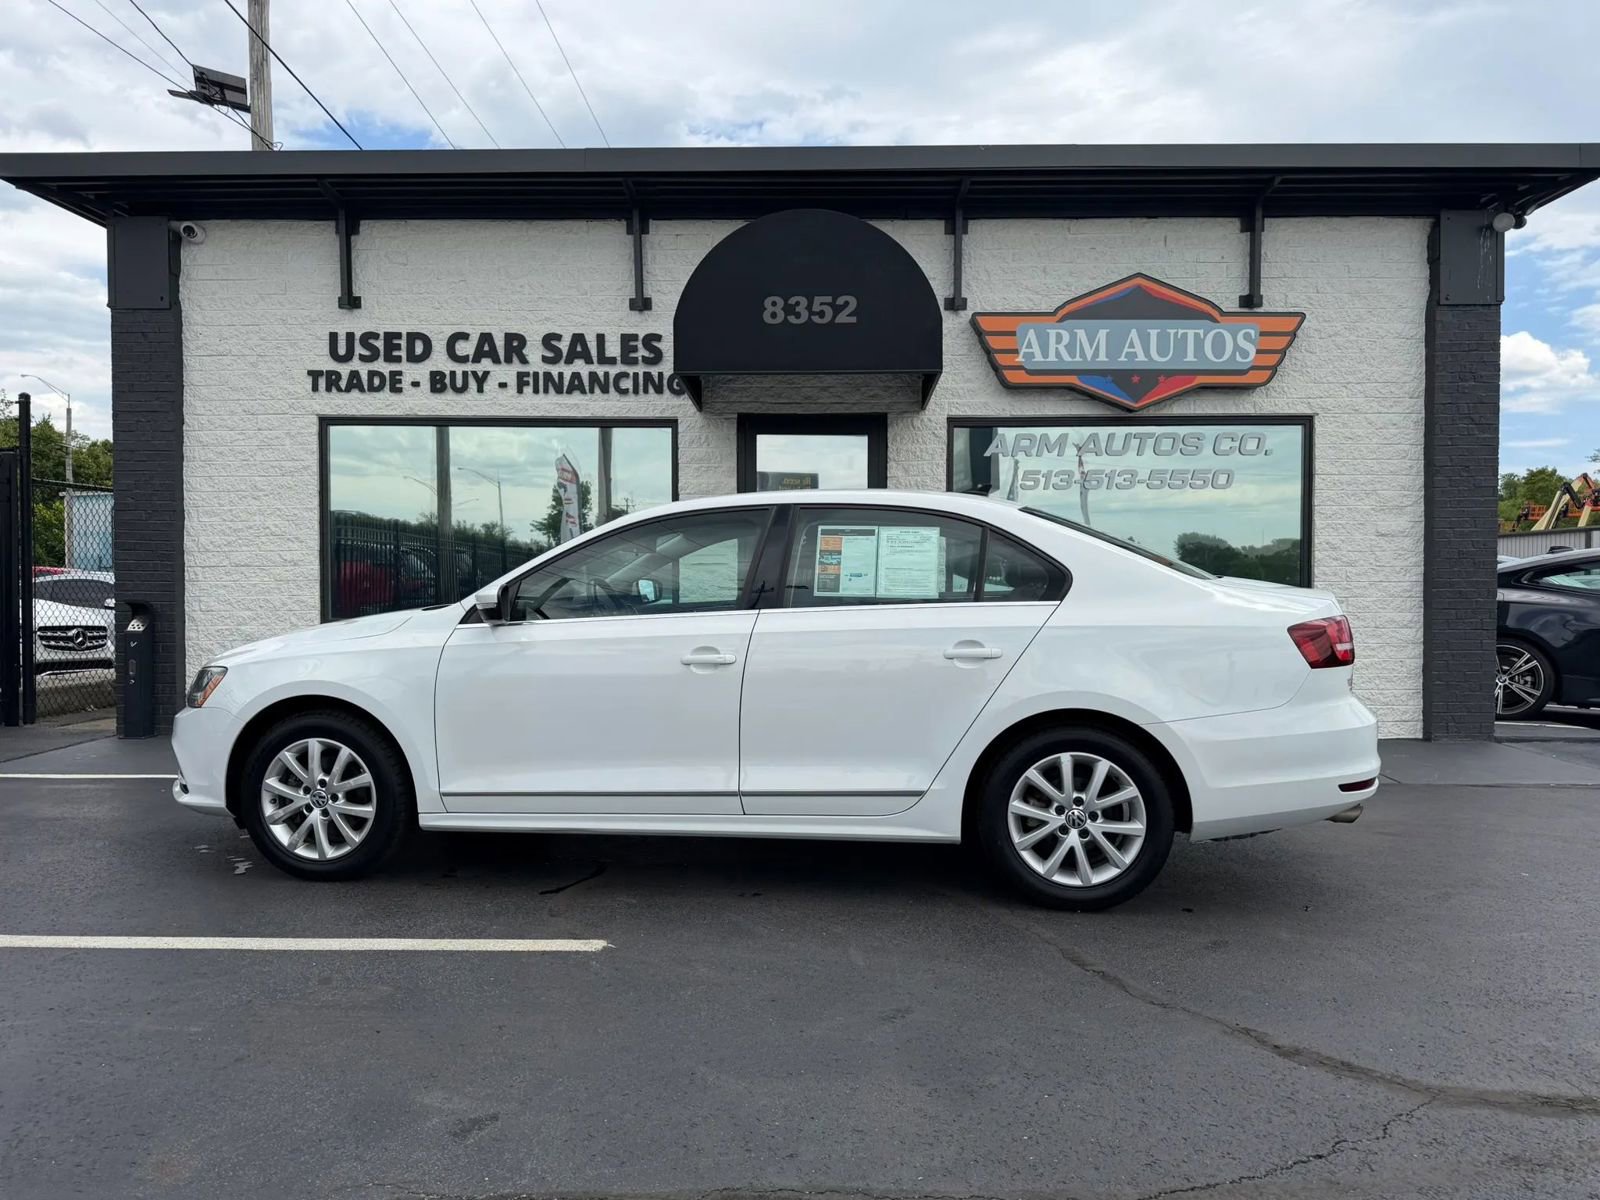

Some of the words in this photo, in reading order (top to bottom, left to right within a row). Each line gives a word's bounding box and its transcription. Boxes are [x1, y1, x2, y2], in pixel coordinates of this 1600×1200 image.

[762, 295, 858, 325] 8352
[328, 331, 433, 363] USED
[446, 331, 530, 364] CAR
[541, 332, 664, 366] SALES
[1015, 328, 1110, 362] ARM
[1117, 328, 1257, 363] AUTOS
[307, 370, 403, 393] TRADE
[429, 370, 491, 394] BUY
[516, 371, 687, 396] FINANCING
[984, 432, 1069, 457] ARM
[1077, 432, 1206, 457] AUTOS
[1212, 432, 1273, 457] CO.
[1019, 469, 1236, 491] 513-513-5550
